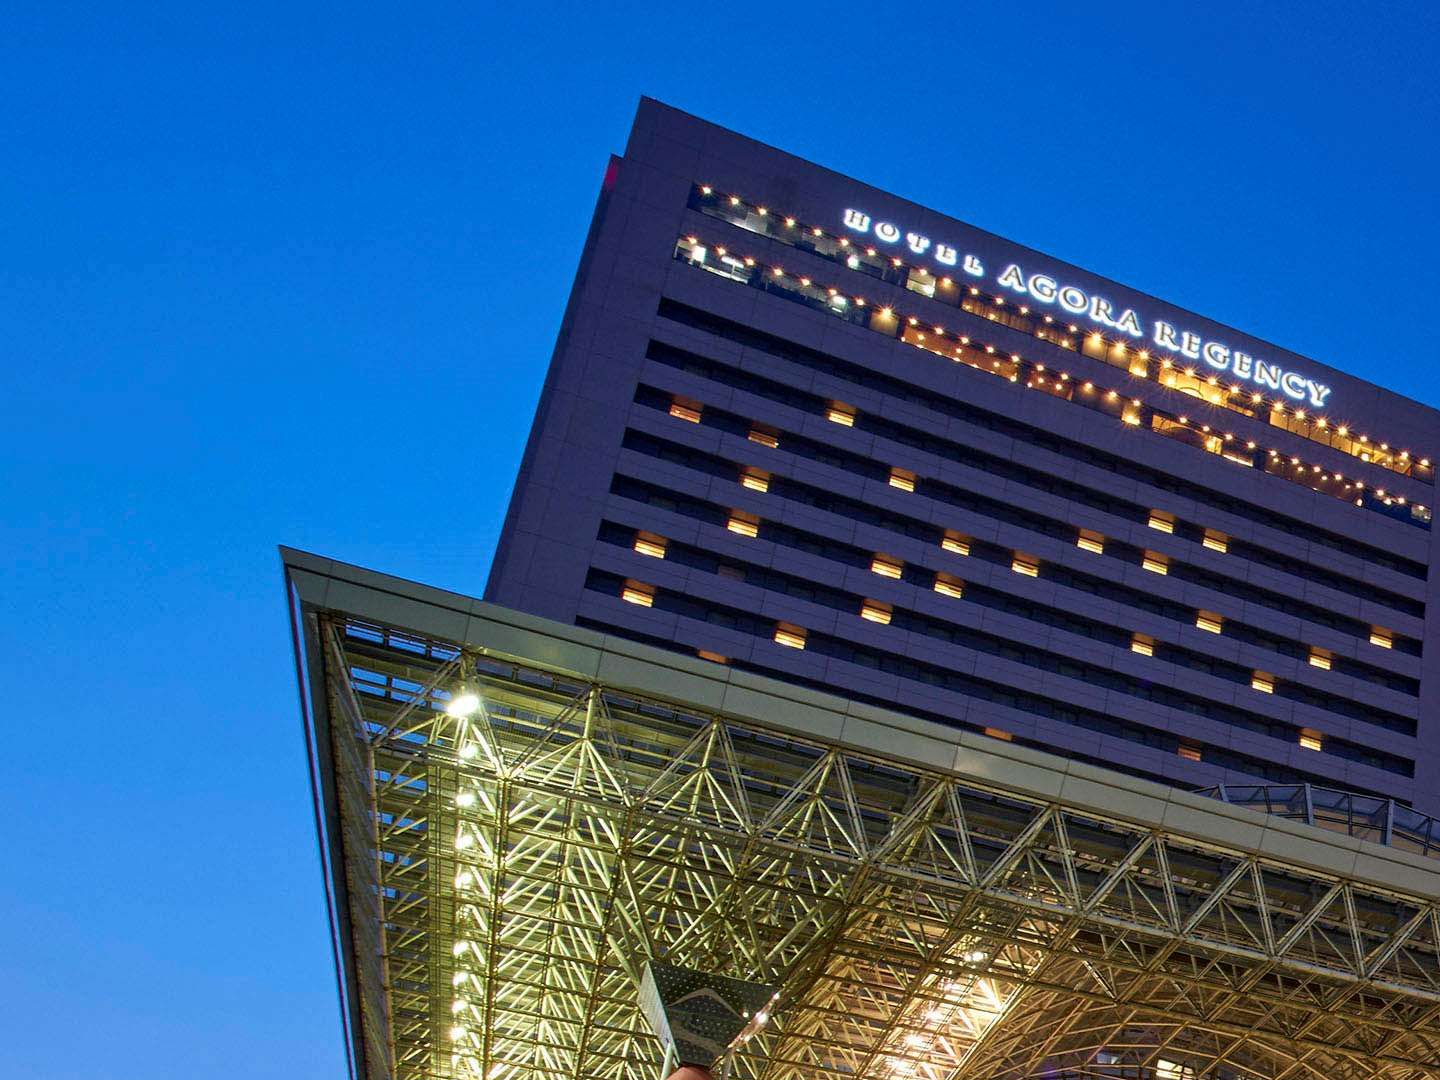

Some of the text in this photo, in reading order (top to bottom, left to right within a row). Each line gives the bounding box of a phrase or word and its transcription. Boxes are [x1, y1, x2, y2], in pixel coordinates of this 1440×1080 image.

[843, 207, 1332, 408] HOTEL AGORA REGENCY
